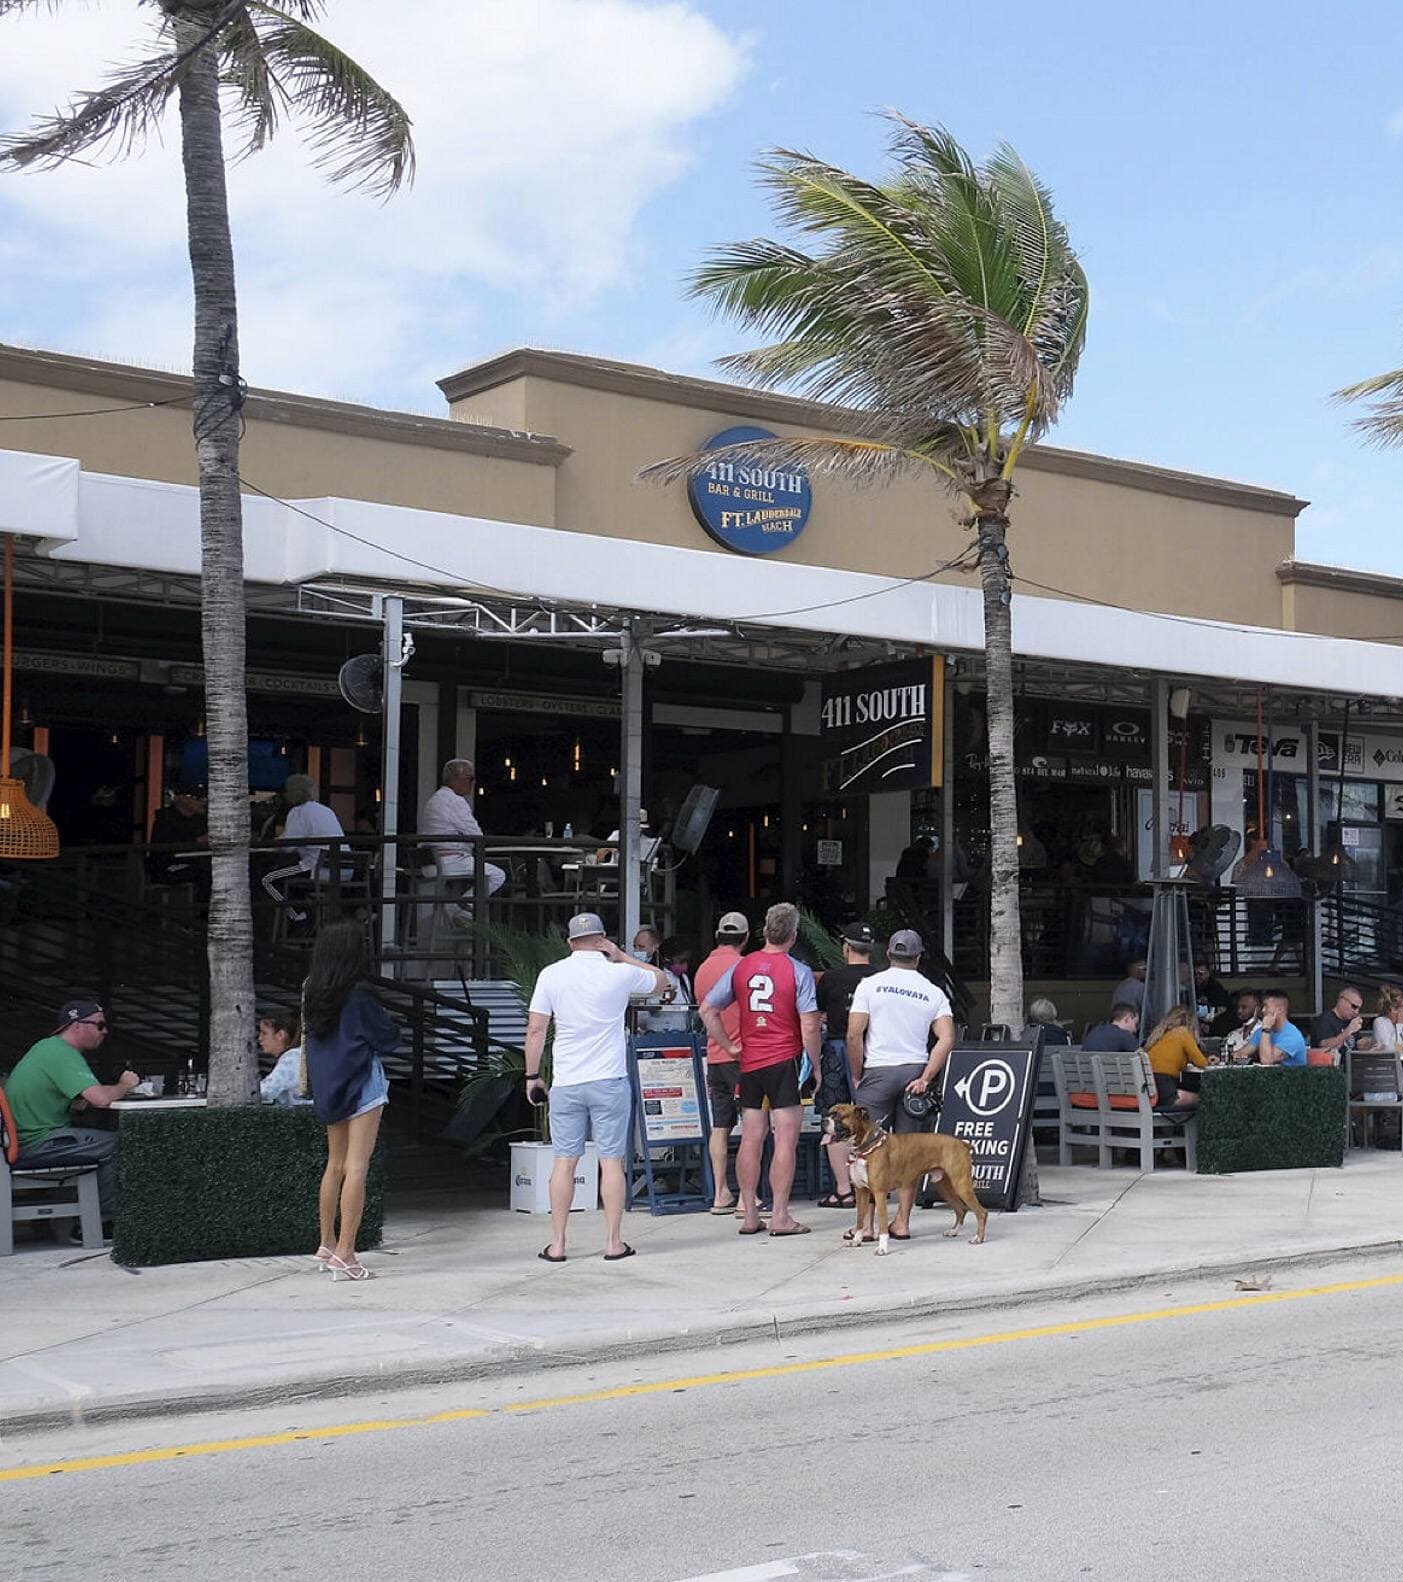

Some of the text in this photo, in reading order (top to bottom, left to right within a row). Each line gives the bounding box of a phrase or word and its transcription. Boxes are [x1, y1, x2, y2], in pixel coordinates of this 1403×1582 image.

[708, 482, 775, 503] BAR & GRILL
[739, 465, 802, 493] SOUTH
[821, 684, 926, 728] 411 SOUTH
[748, 973, 774, 1013] 2
[978, 1069, 1007, 1108] P
[954, 1121, 994, 1137] FREE
